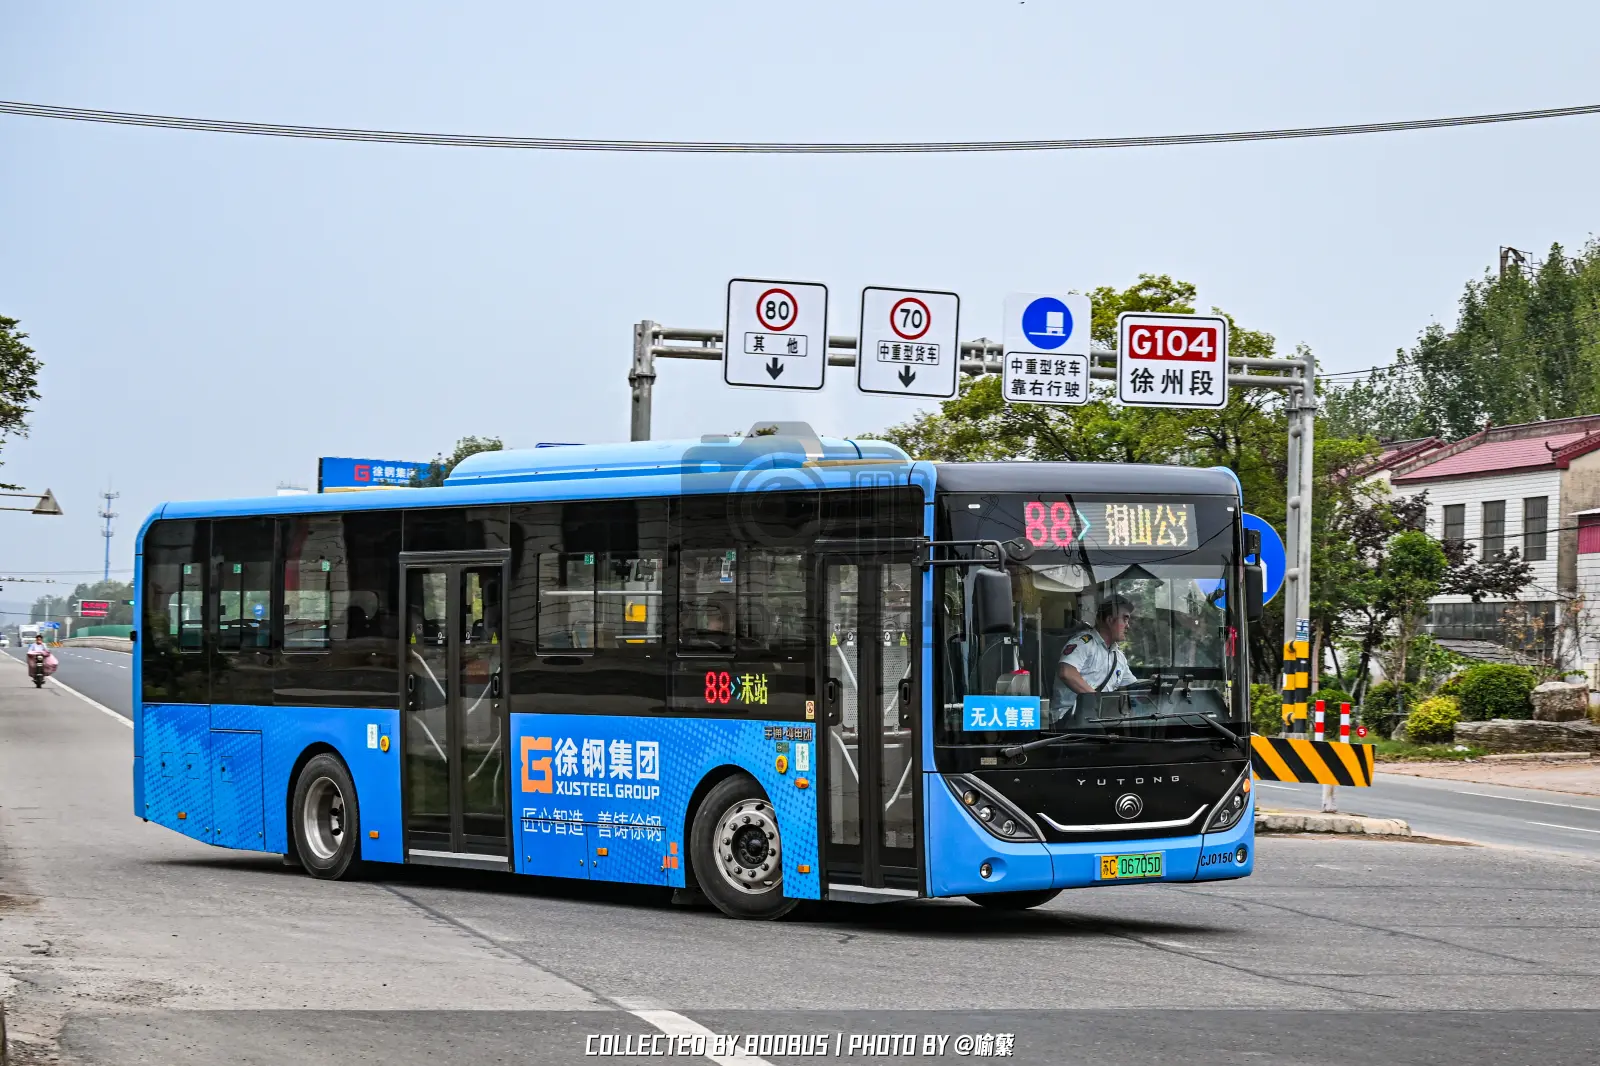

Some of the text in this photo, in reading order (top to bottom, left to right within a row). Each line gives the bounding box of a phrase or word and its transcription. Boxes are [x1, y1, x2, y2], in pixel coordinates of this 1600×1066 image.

[765, 300, 790, 321] 80
[899, 308, 923, 329] 70
[880, 343, 937, 363] 中重型货车
[1131, 328, 1214, 358] G104
[1011, 357, 1082, 377] 中重型货车
[1011, 378, 1081, 398] 靠右行驶
[1130, 367, 1215, 396] 徐州段
[1026, 502, 1073, 546] 88
[705, 671, 731, 704] 88
[740, 673, 769, 705] 末站
[970, 706, 1035, 728] 无人售票
[554, 737, 660, 781] 徐钢集团
[555, 780, 660, 800] XUSTEEL GROUP
[1077, 775, 1180, 786] YUTONG
[522, 807, 663, 842] 匠心智造 善铸徐钢
